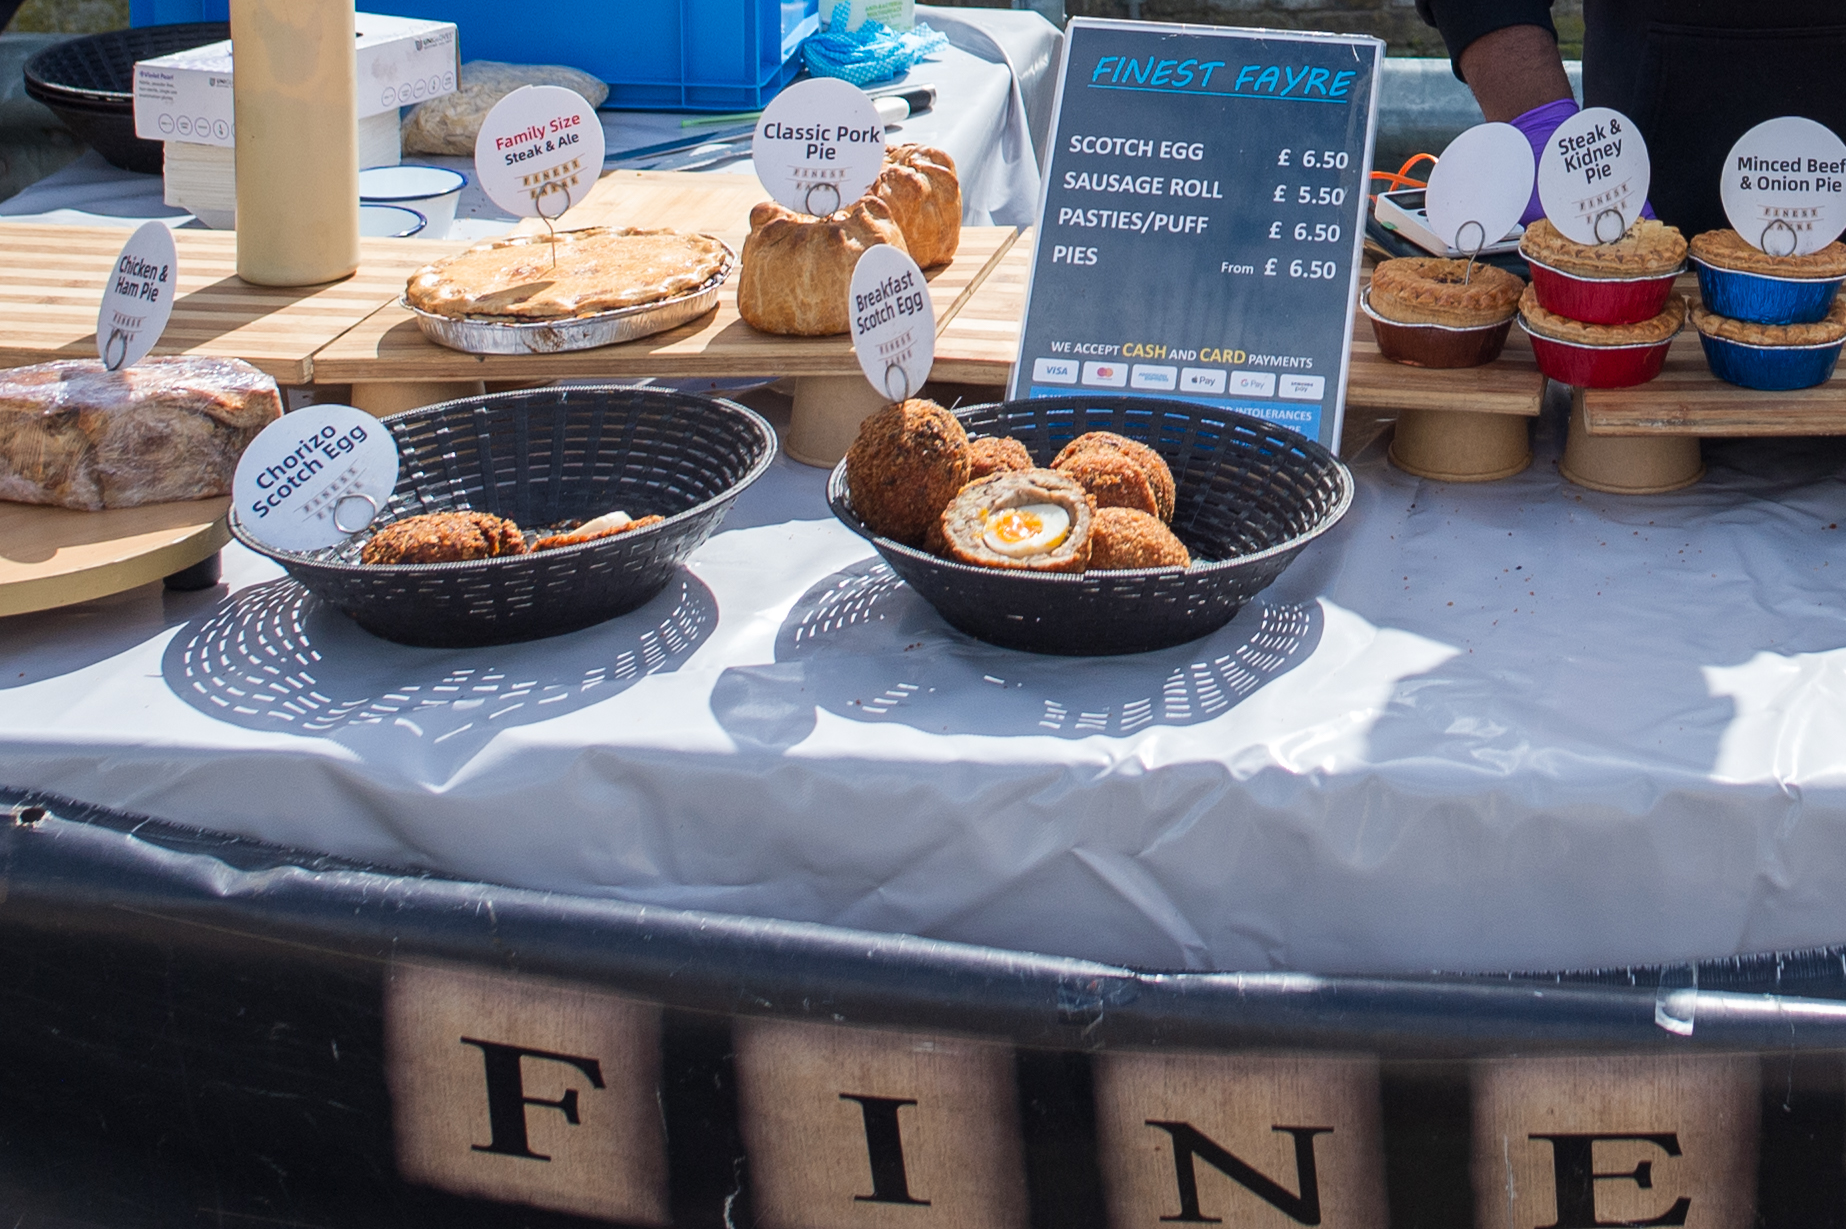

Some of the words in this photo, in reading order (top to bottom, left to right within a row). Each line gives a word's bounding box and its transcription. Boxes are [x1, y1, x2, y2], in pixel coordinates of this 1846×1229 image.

[1091, 56, 1226, 88] FINEST
[1234, 65, 1357, 98] FAYRE
[496, 126, 545, 150] Family
[550, 114, 580, 133] Size
[764, 122, 830, 141] Classic
[837, 126, 880, 143] Pork
[1558, 123, 1607, 156] Steak
[1610, 118, 1622, 134] &
[505, 144, 543, 166] Steak
[545, 140, 555, 152] &
[558, 133, 579, 148] Ale
[806, 143, 836, 160] Pie
[1069, 135, 1154, 158] SCOTCH
[1159, 141, 1204, 160] EGG
[1278, 149, 1291, 167] £
[1302, 150, 1349, 169] 6.50
[1564, 138, 1623, 173] Kidney
[1737, 156, 1802, 172] Minced
[1807, 158, 1846, 173] Beef
[1063, 171, 1163, 196] SAUSAGE
[1170, 178, 1223, 199] ROLL
[1273, 185, 1286, 203] £
[1298, 187, 1344, 206] 5.50
[1585, 163, 1612, 185] Pie
[1740, 176, 1752, 190] &
[1757, 175, 1810, 192] Onion
[1816, 177, 1842, 192] Pie
[1058, 207, 1209, 234] PASTIES/PUFF
[1268, 221, 1282, 239] £
[1293, 222, 1341, 243] 6.50
[119, 255, 158, 280] Chicken
[159, 264, 168, 282] &
[1051, 245, 1098, 265] PIES
[1221, 261, 1254, 276] From
[1264, 258, 1278, 276] £
[1289, 260, 1337, 279] 6.50
[115, 276, 139, 297] Ham
[139, 282, 159, 302] Pie
[855, 270, 914, 314] Breakfast
[857, 302, 895, 335] Scotch
[896, 291, 924, 316] Egg
[1046, 366, 1068, 375] VISA
[1051, 341, 1071, 352] WE
[1074, 343, 1120, 356] ACCEPT
[1122, 343, 1167, 359] CASH
[1169, 349, 1197, 361] AND
[1199, 347, 1246, 365] CARD
[1248, 354, 1313, 368] PAYMENTS
[1200, 376, 1215, 386] Pay
[1250, 380, 1265, 389] Pay
[252, 459, 324, 518] Scotch
[322, 425, 368, 460] Egg
[256, 425, 337, 490] Chorizo
